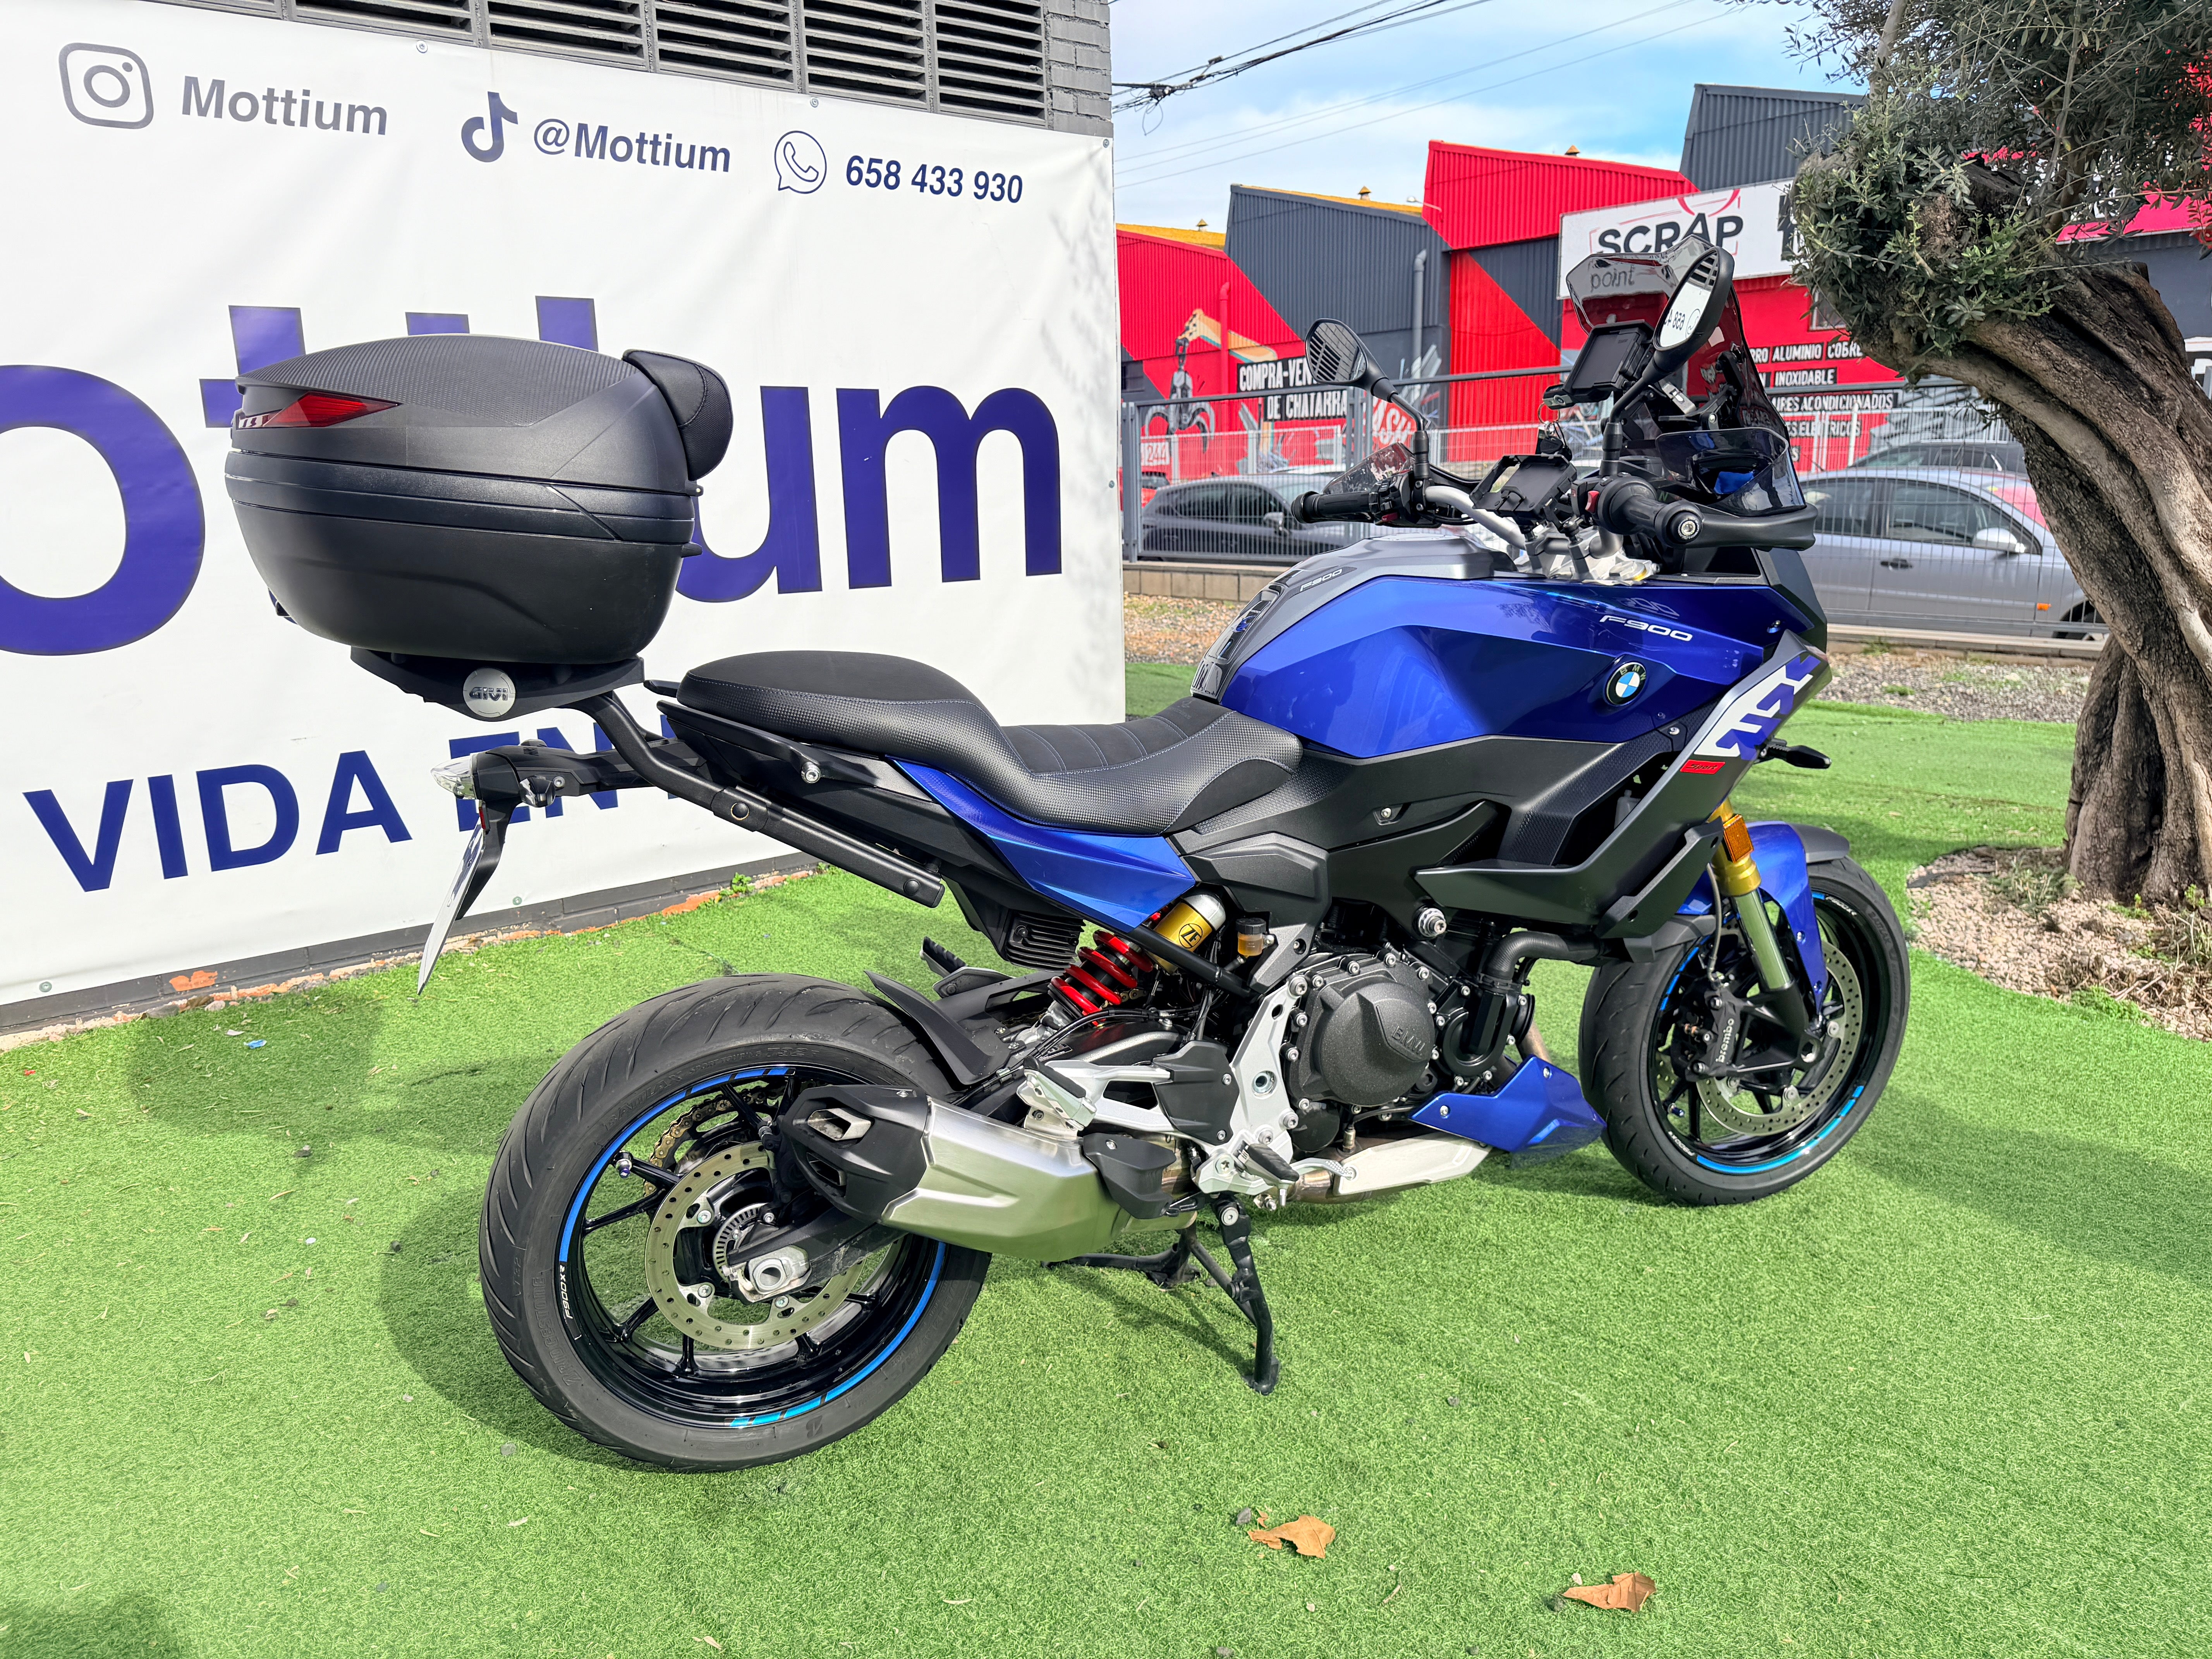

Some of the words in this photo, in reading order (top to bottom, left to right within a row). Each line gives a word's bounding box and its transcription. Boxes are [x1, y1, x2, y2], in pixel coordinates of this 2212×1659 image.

[182, 76, 387, 135] Mottium
[534, 118, 730, 172] @Mottium
[846, 155, 901, 190] 658
[911, 165, 963, 197] 433
[974, 170, 1022, 203] 930
[1599, 213, 1743, 253] SCRAP
[1591, 266, 1635, 292] point
[1772, 344, 1822, 362] ALUMINIO
[1239, 357, 1317, 392] COMPRA-VEN
[1775, 369, 1835, 386] INOXIDABLE
[1267, 395, 1281, 419] DE
[1286, 390, 1347, 419] CHATARRA
[1300, 568, 1342, 592] F900
[1599, 615, 1693, 641] F900
[1620, 664, 1646, 681] BMW
[22, 750, 412, 892] VIDA
[1392, 1025, 1425, 1054] BMW
[1716, 1018, 1734, 1063] brembo
[560, 1264, 573, 1319] F900XR
